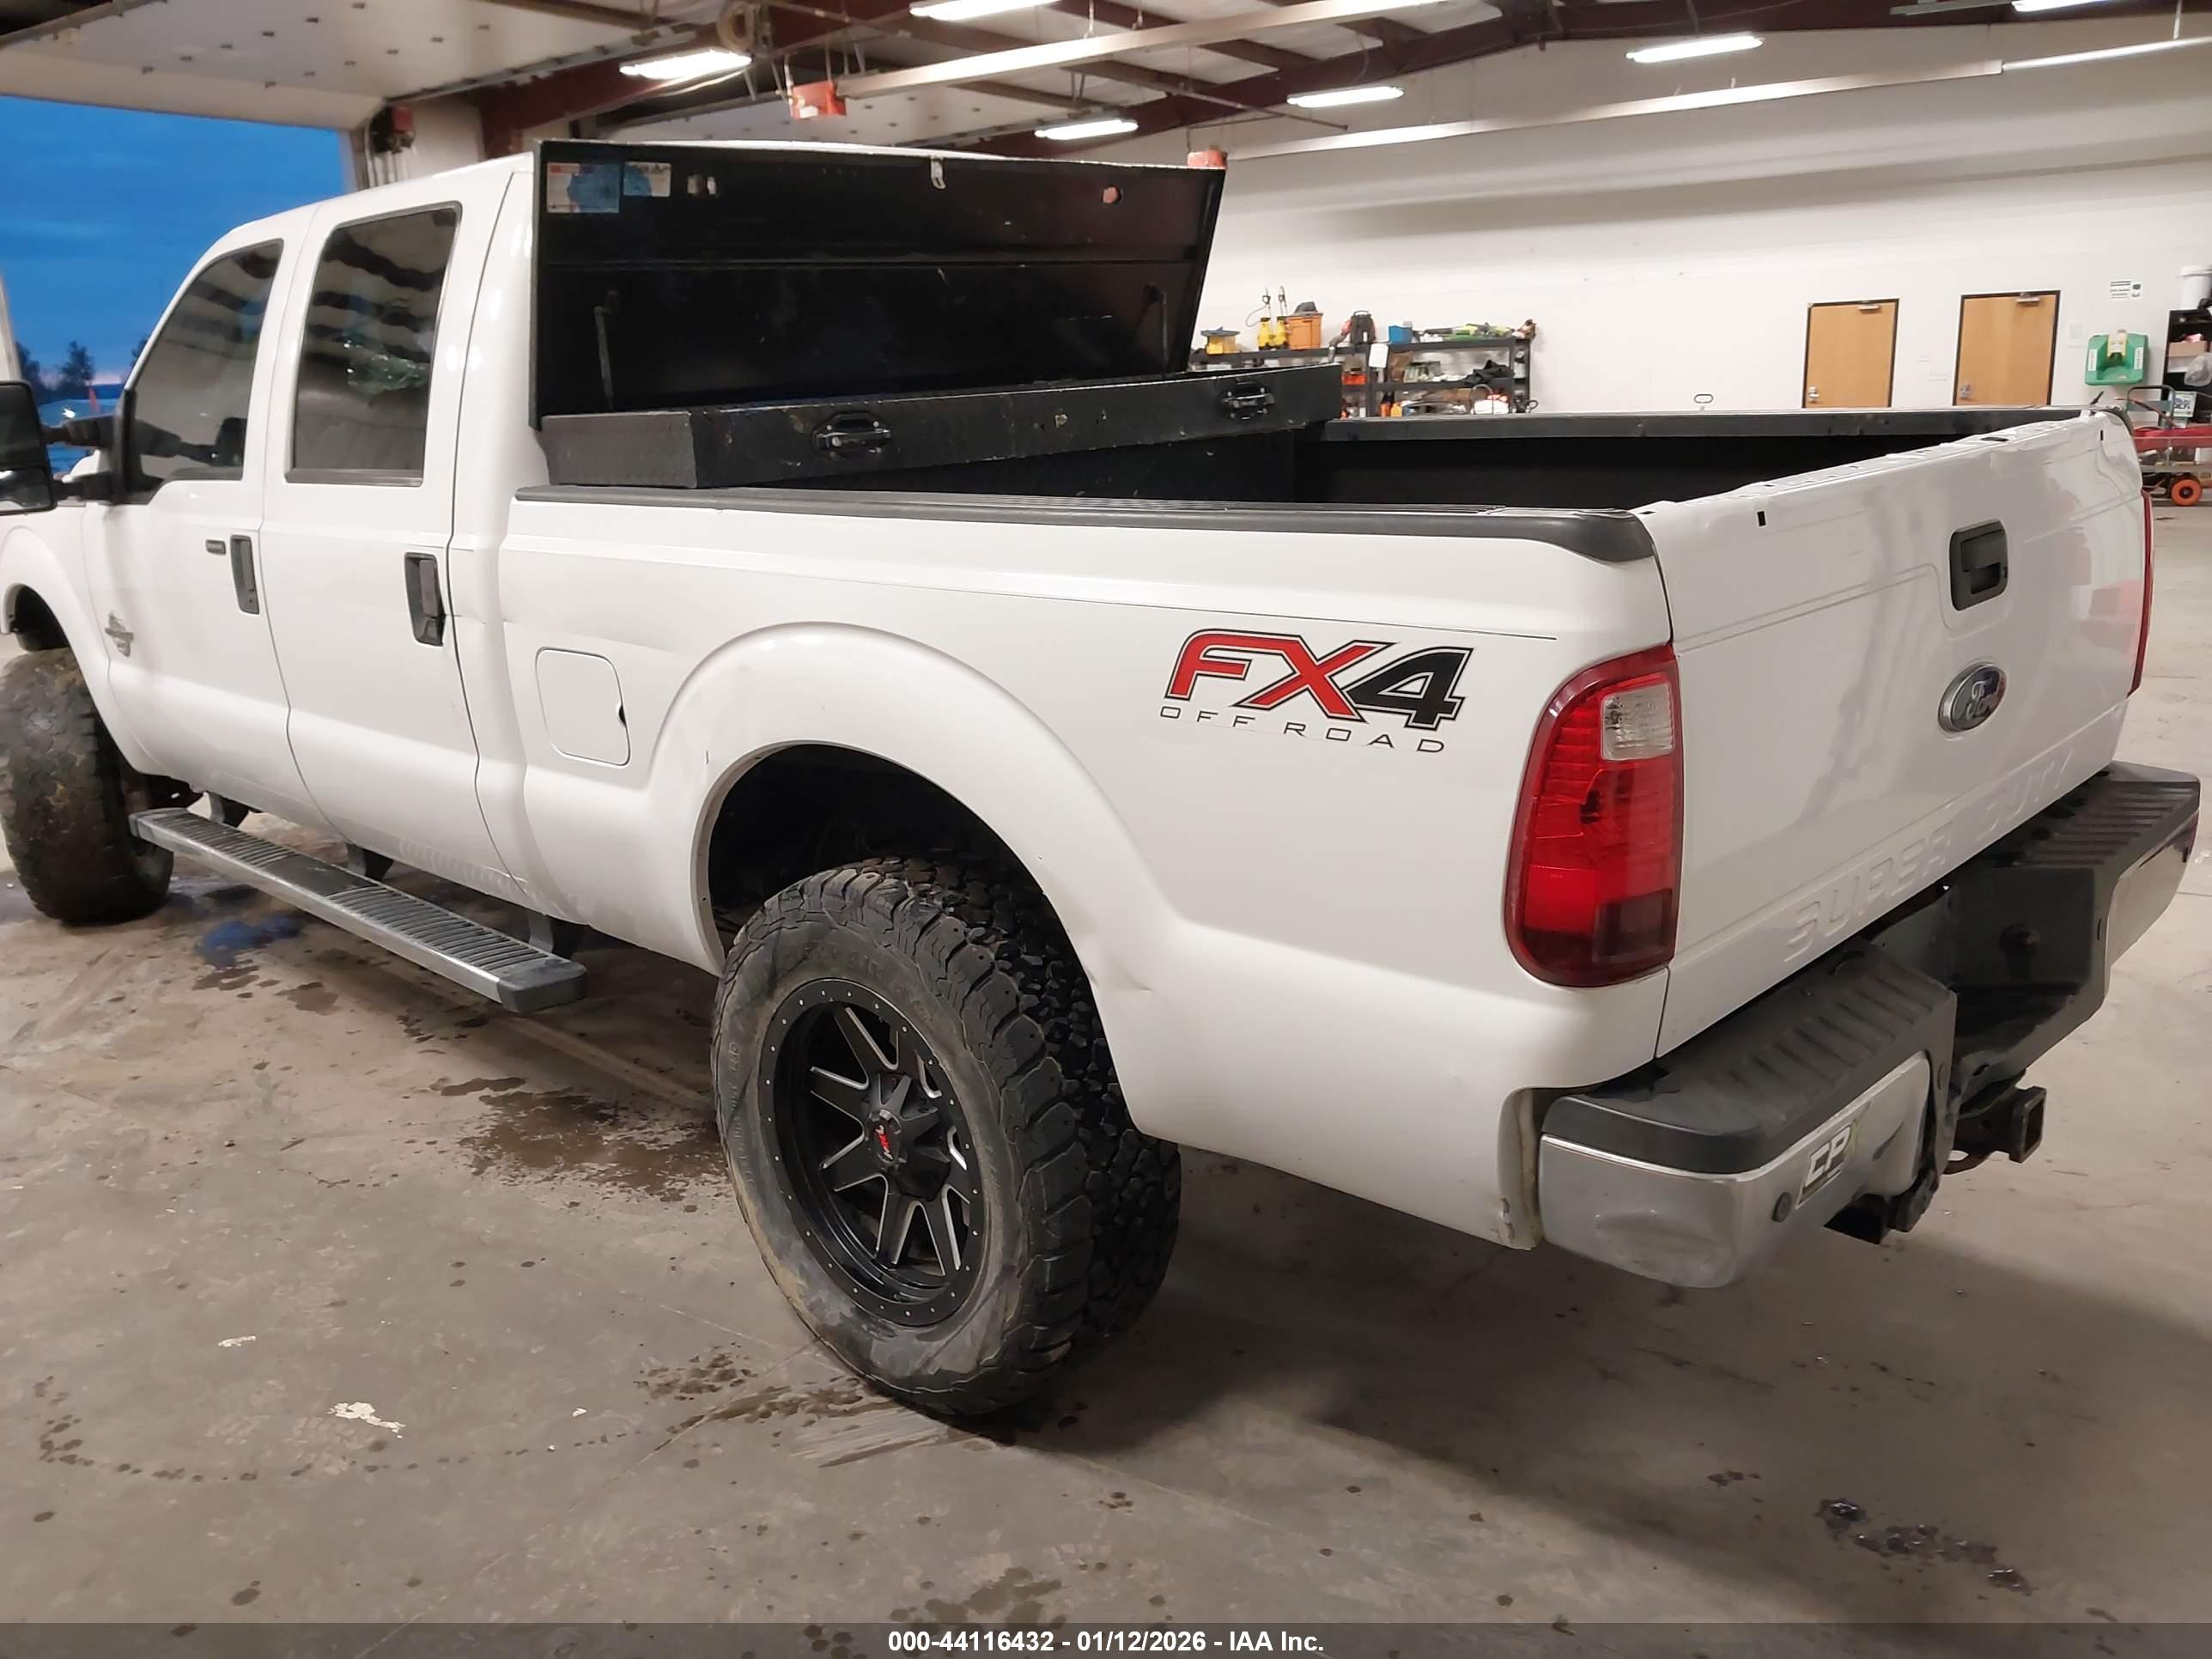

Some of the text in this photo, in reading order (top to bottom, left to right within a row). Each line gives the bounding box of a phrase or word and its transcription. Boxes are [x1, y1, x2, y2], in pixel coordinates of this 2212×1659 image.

[1159, 706, 1445, 753] OFF ROAD
[1164, 628, 1474, 732] FX4
[1784, 820, 1954, 963] SUPER
